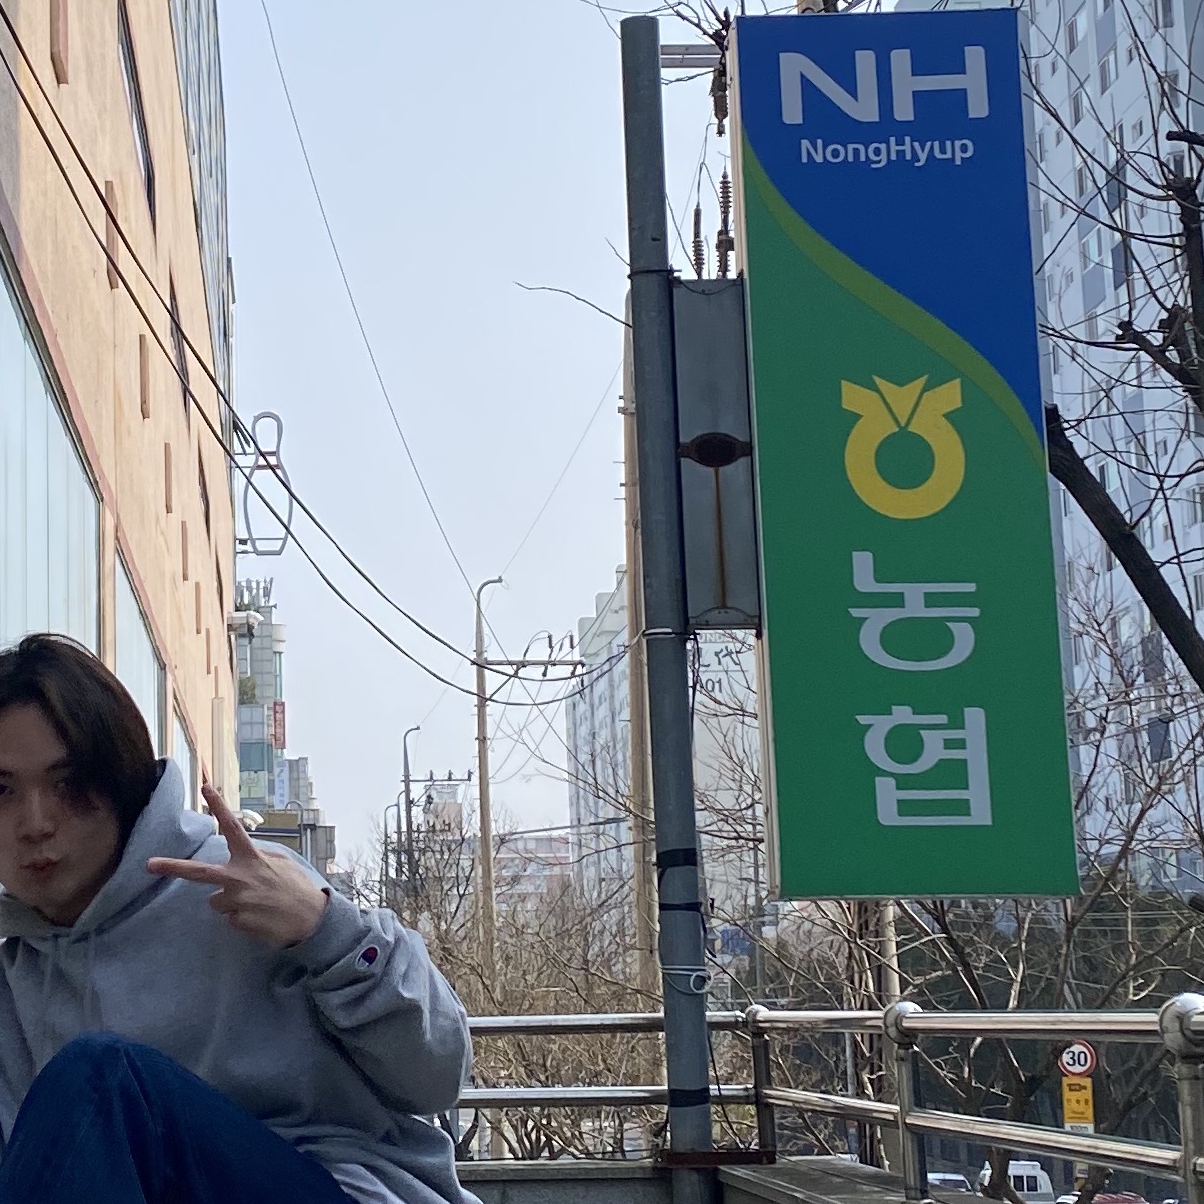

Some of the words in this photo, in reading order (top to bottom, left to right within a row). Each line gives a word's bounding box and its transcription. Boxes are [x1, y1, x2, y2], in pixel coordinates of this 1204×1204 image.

[778, 45, 990, 125] NH
[799, 136, 975, 168] NongHyup
[847, 550, 993, 826] 농협
[1065, 1050, 1088, 1067] 30
